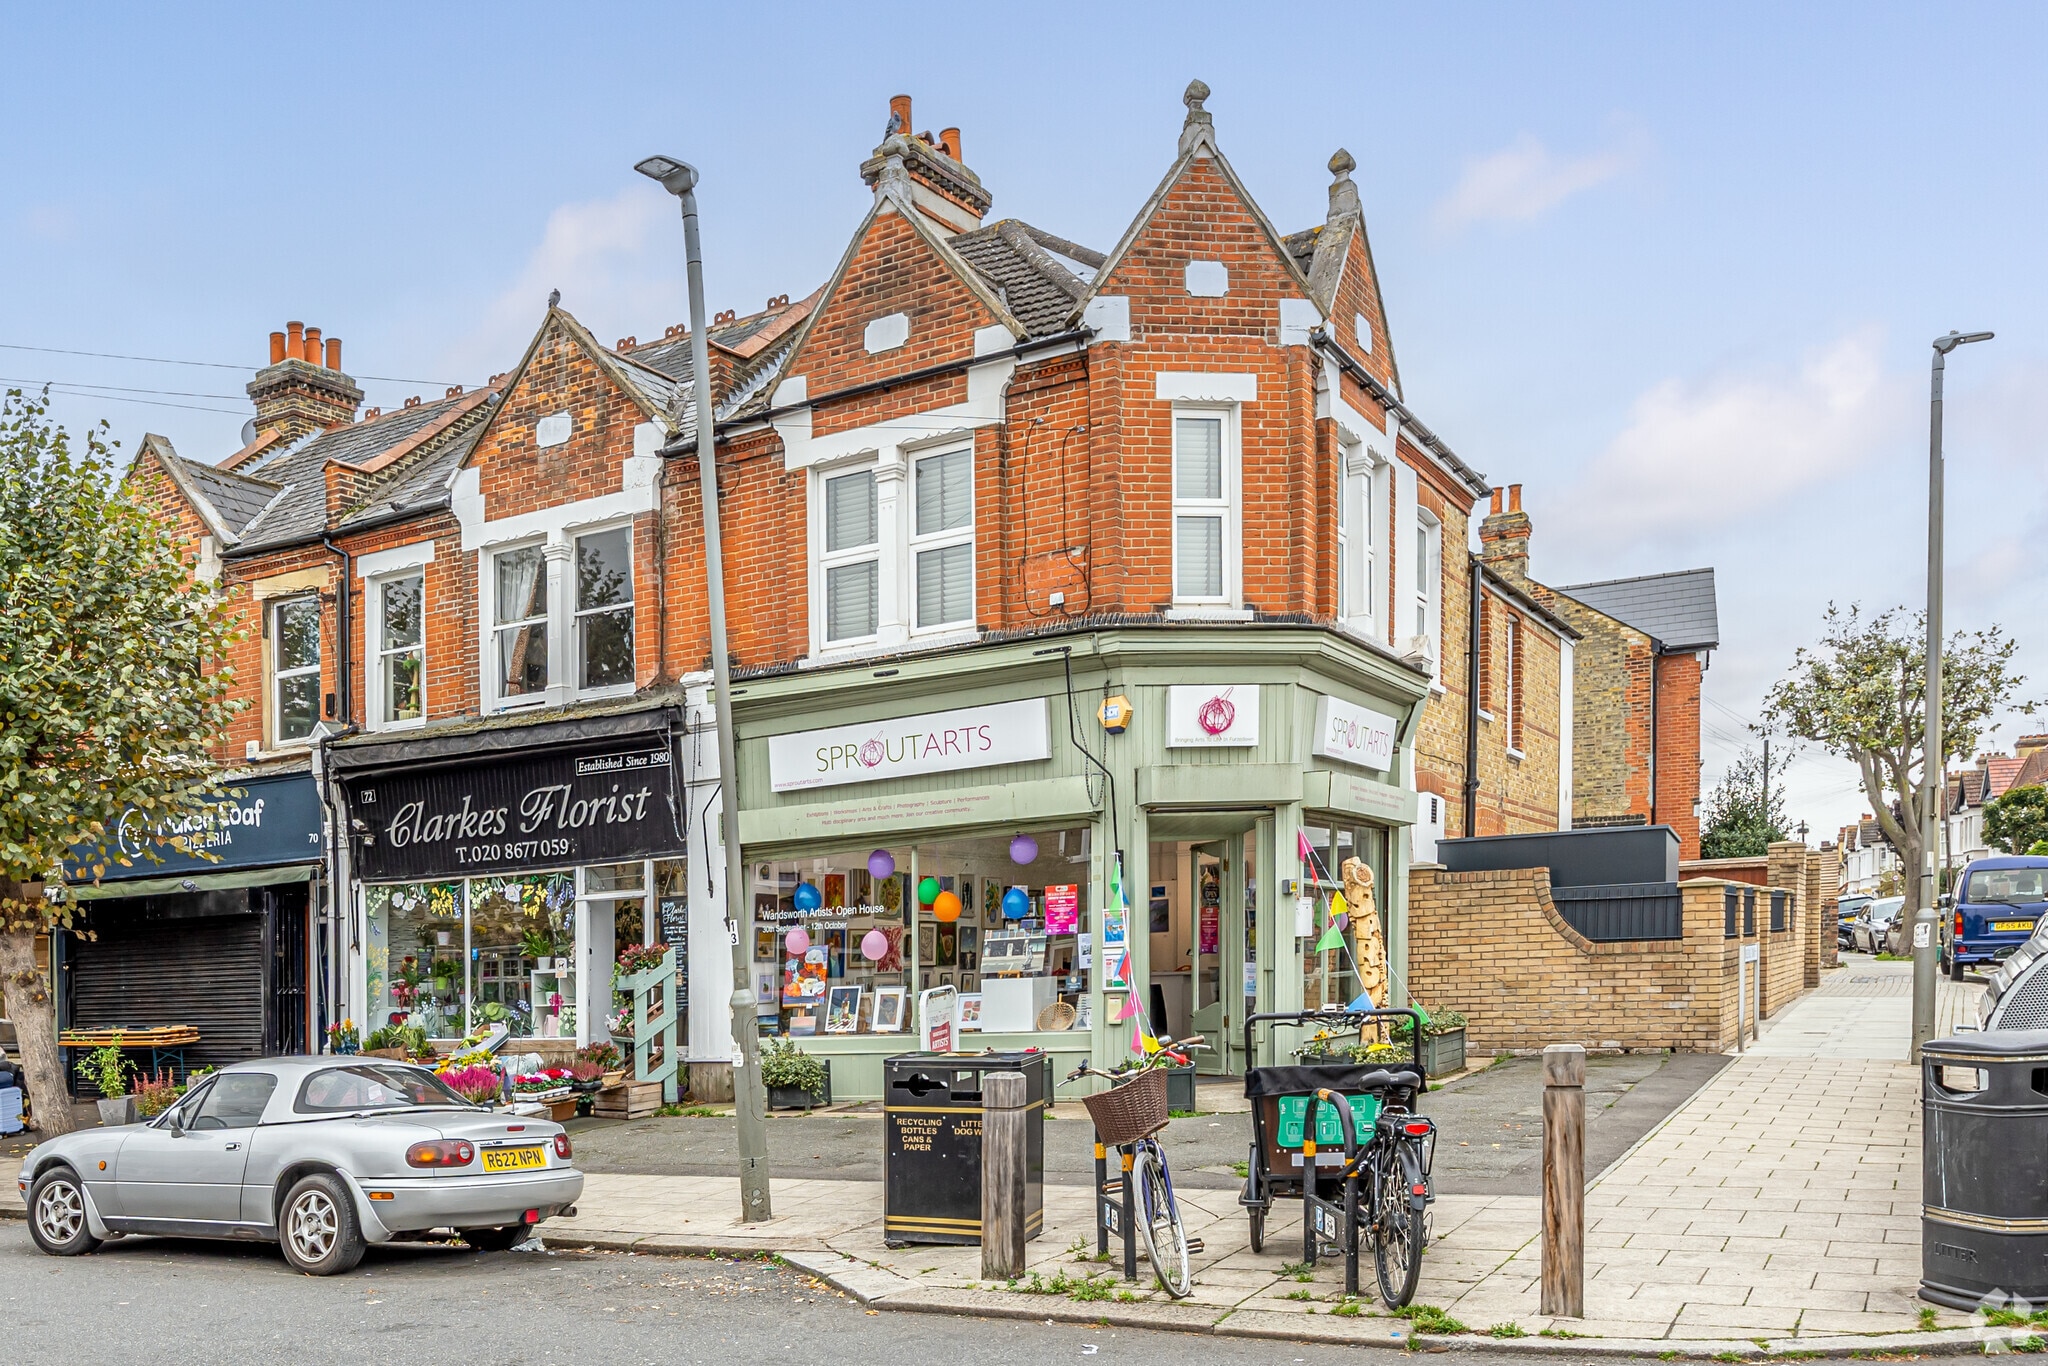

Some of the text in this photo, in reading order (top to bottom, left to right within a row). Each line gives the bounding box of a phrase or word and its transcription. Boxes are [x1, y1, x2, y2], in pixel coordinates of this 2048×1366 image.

[578, 752, 670, 772] Established Since 1980
[364, 791, 373, 802] 72
[218, 798, 265, 828] Loaf
[385, 784, 652, 848] Clarkes Florist
[308, 833, 319, 844] 70
[456, 844, 500, 864] T.020
[762, 904, 884, 920] Wandsworth Artists' Open House
[762, 924, 775, 933] 30th
[812, 922, 824, 930] 12th
[824, 921, 848, 930] October
[896, 1118, 942, 1127] RECYCLING
[960, 1120, 982, 1128] LITTE
[901, 1127, 938, 1135] BOTTLES
[954, 1128, 973, 1136] DOG
[926, 1136, 932, 1144] &
[904, 1144, 932, 1152] PAPER
[486, 1149, 542, 1168] R622 NPN
[1934, 1241, 1979, 1264] LITTER
